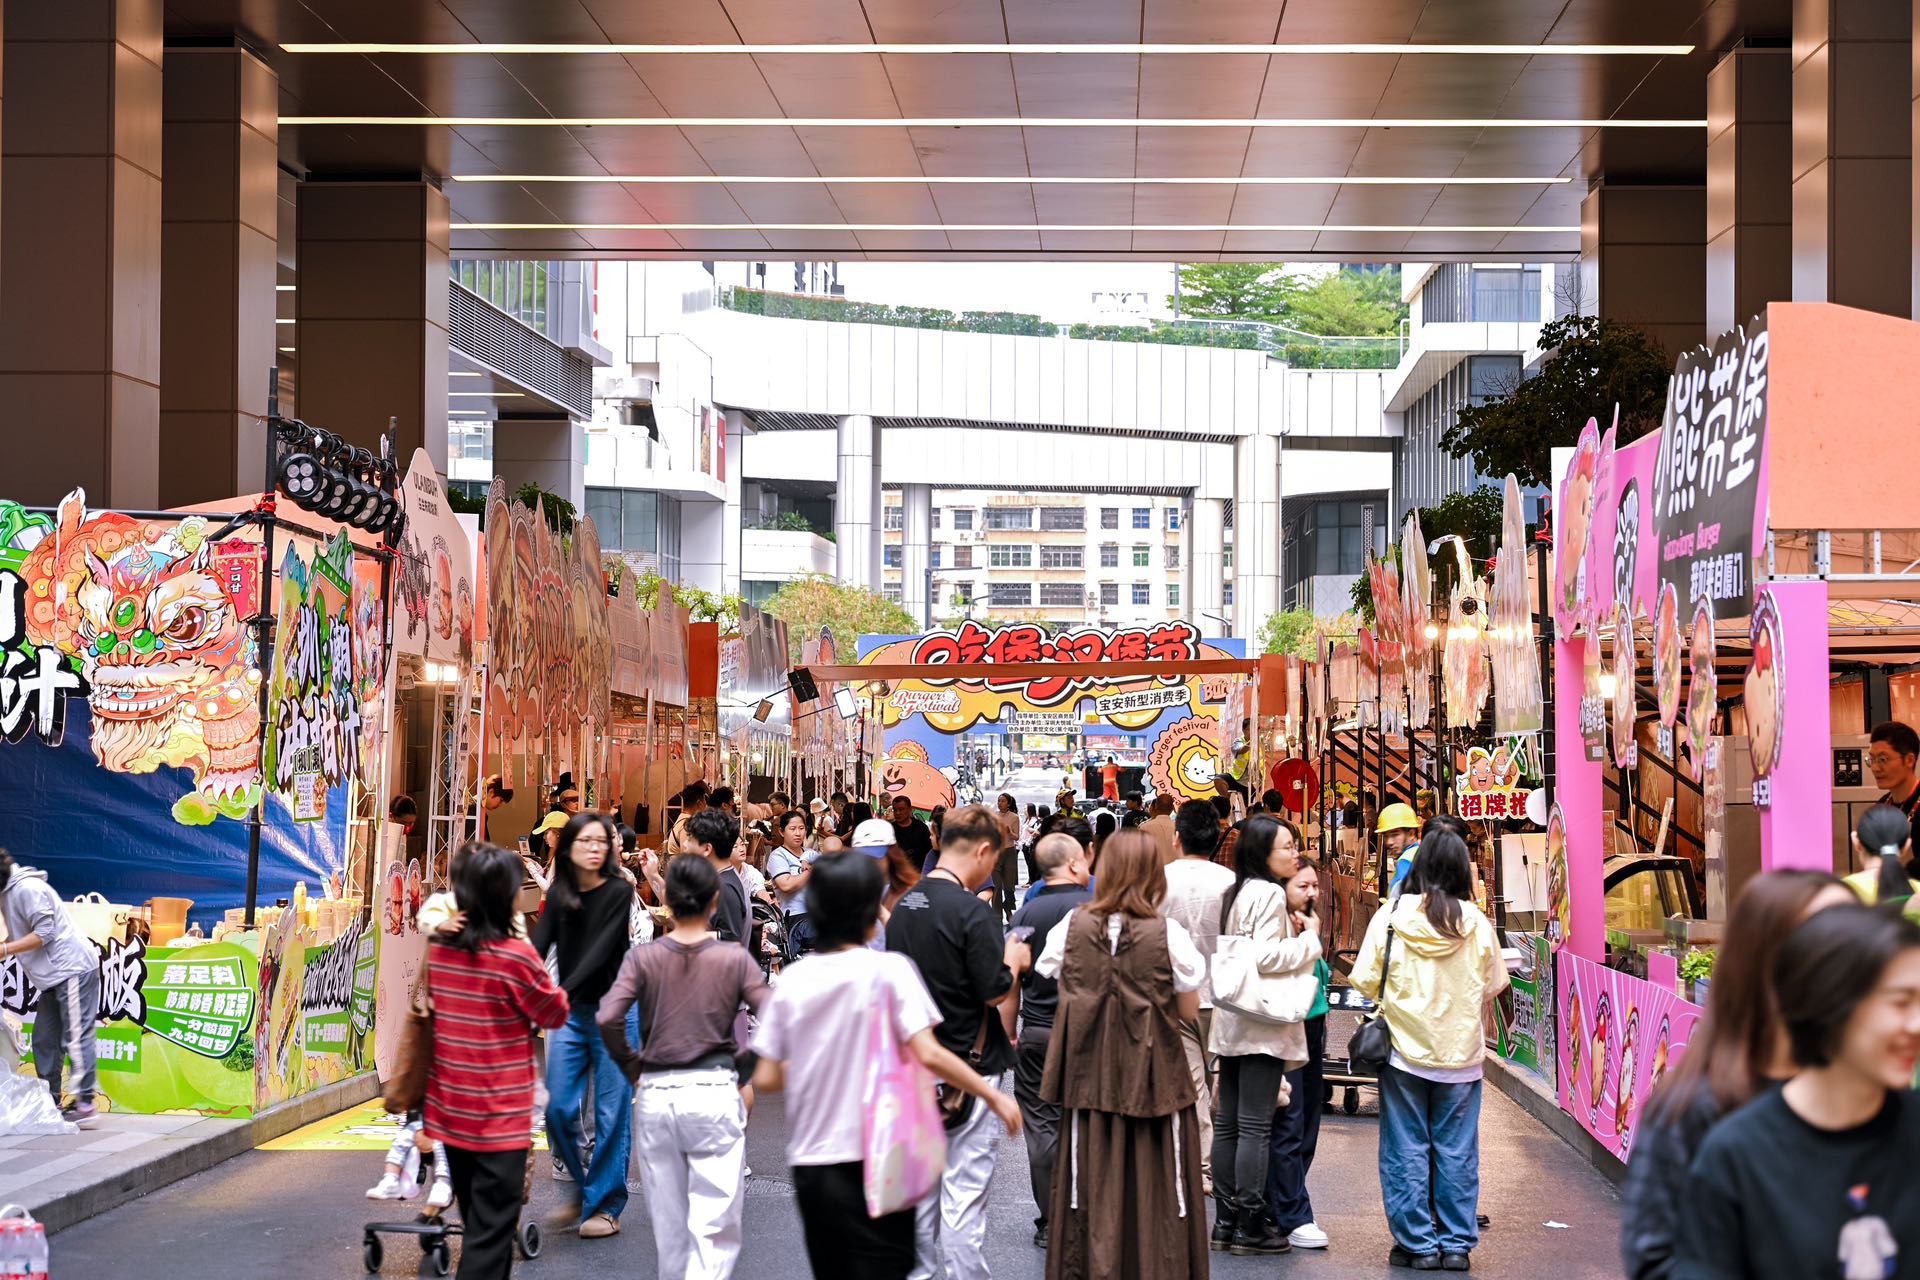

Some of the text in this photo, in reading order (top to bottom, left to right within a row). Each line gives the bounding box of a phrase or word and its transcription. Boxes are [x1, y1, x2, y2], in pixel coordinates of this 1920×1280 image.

[1690, 552, 1744, 603] 我们来自厦门
[890, 690, 945, 706] Burger
[899, 700, 960, 718] Festival
[1098, 688, 1188, 711] 宝安新型消费季
[1154, 721, 1210, 766] burger festival
[168, 1027, 230, 1051] 九分回甘
